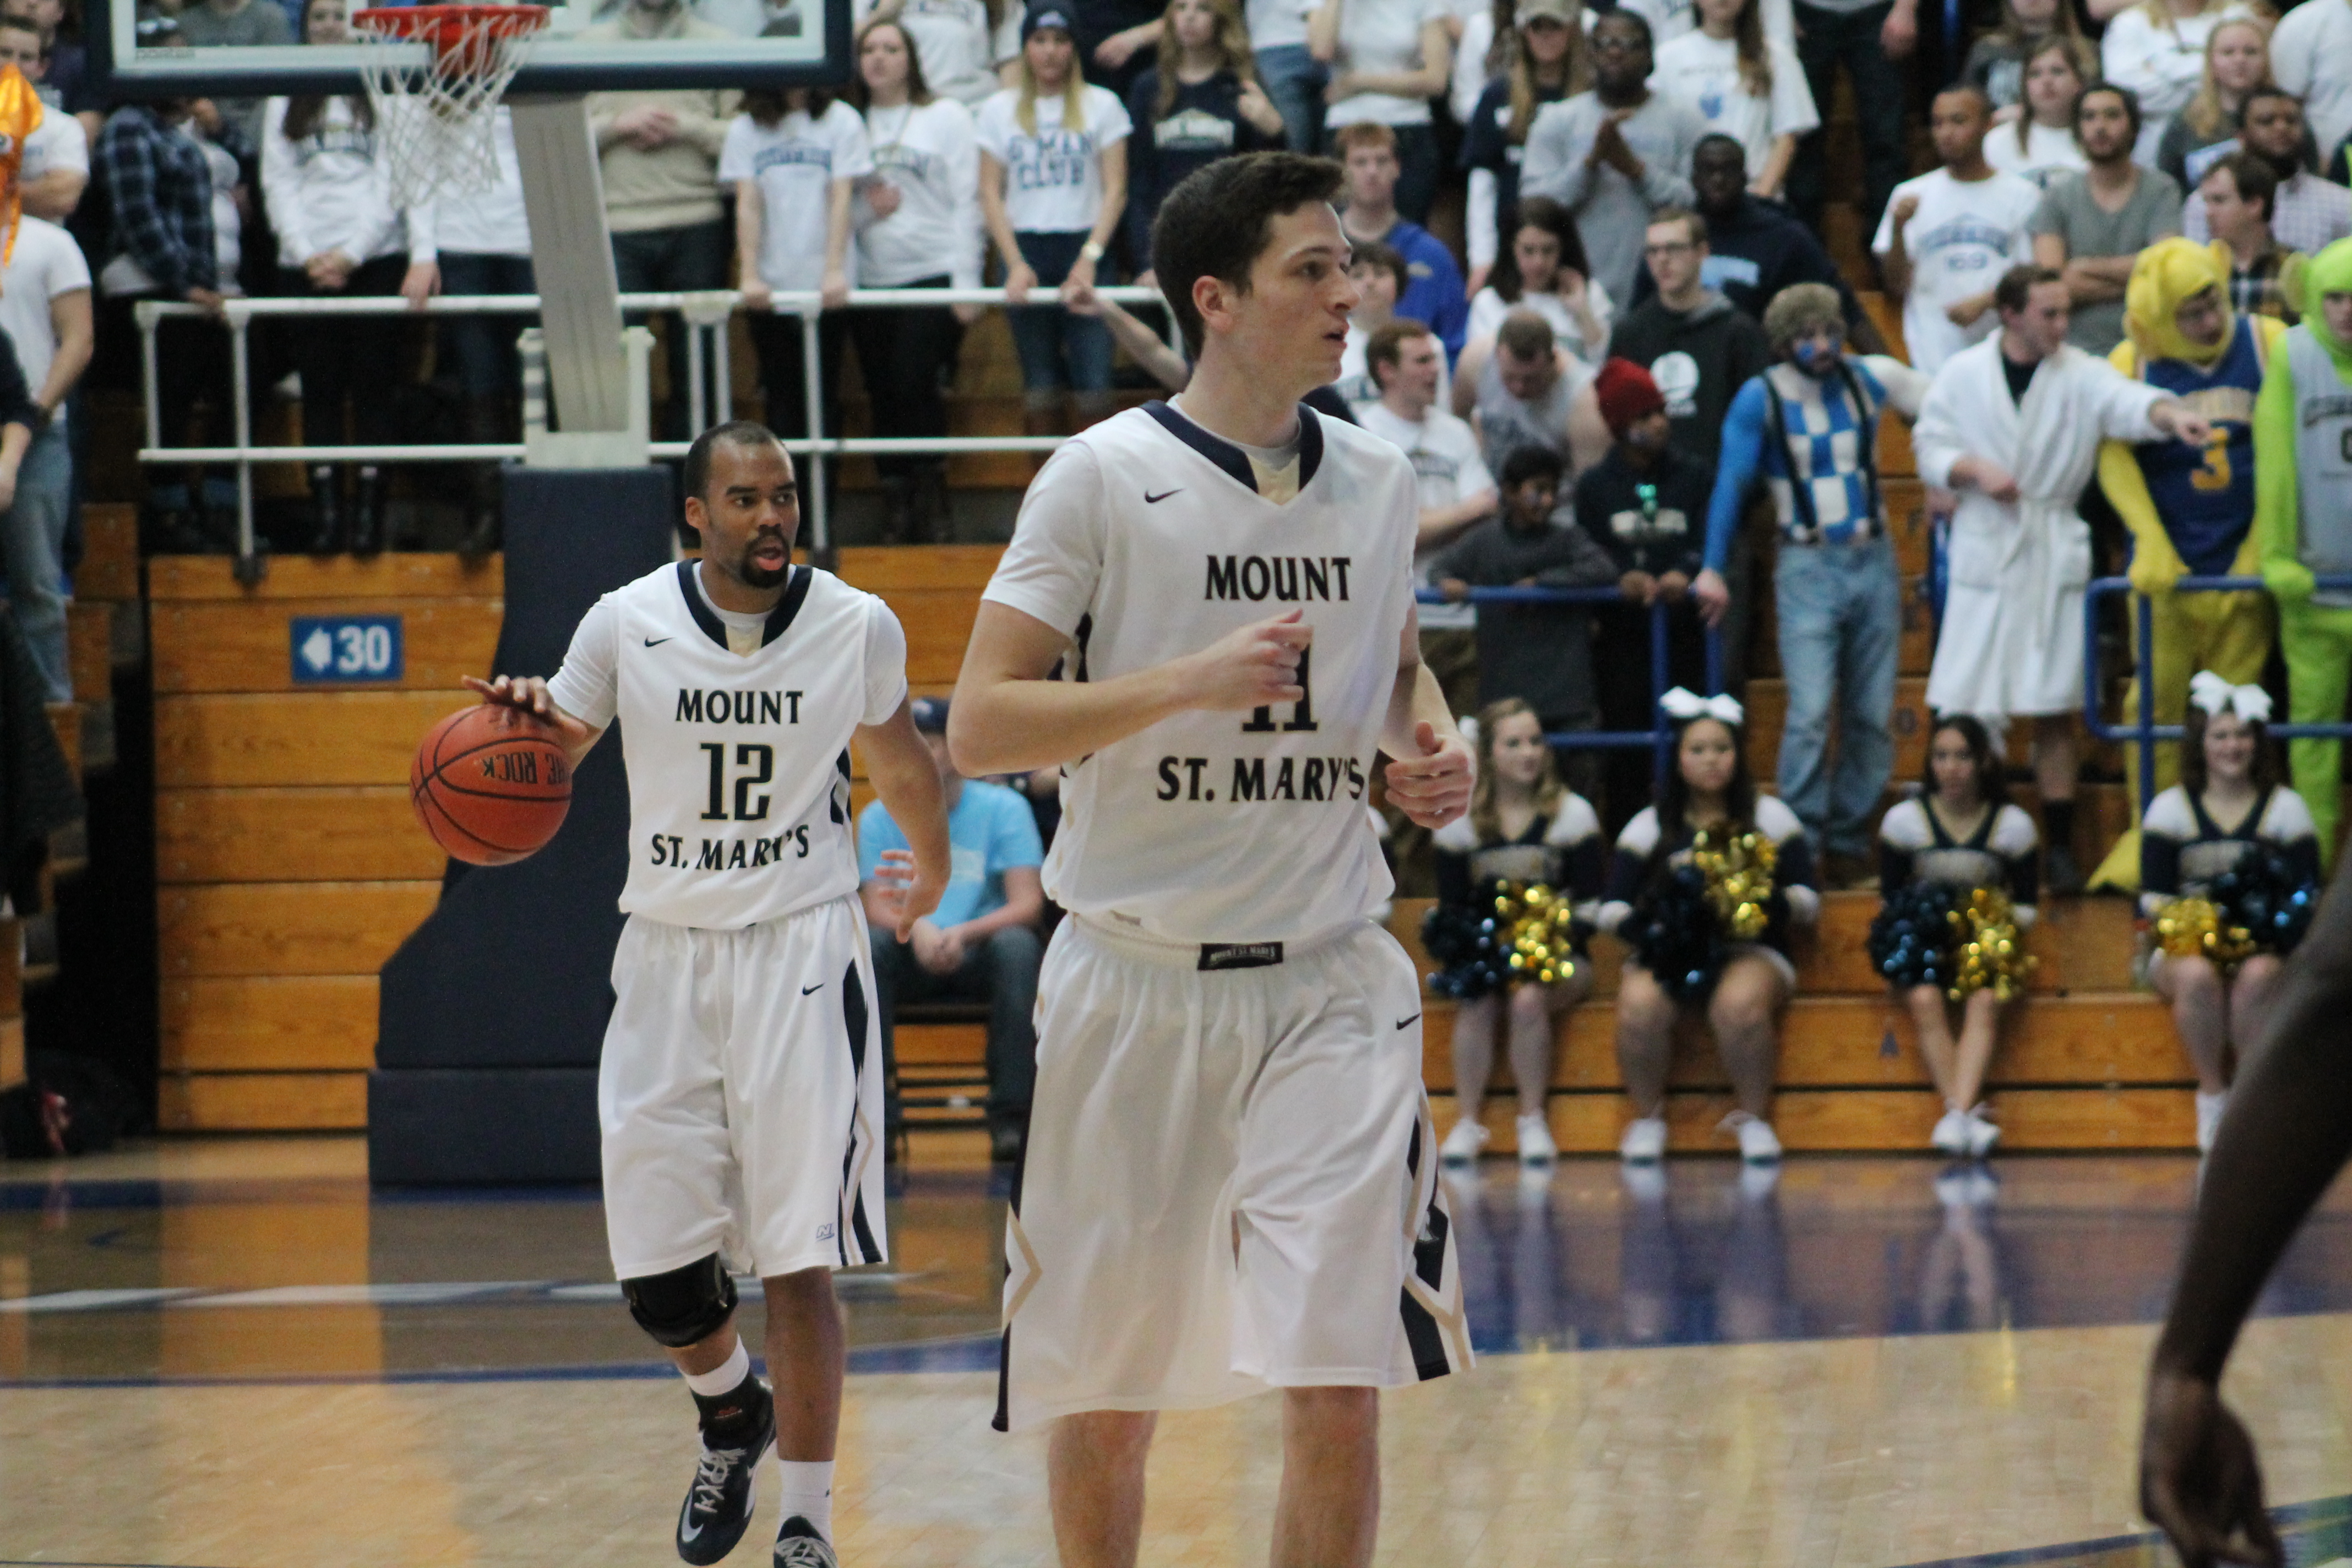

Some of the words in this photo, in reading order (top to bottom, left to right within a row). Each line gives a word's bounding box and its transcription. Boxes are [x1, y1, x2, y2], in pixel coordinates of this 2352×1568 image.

[1017, 159, 1085, 189] CLUB
[2190, 426, 2231, 491] 3
[1205, 554, 1351, 602] MOUNT
[338, 625, 391, 673] 30
[675, 688, 803, 725] MOUNT
[482, 751, 538, 785] ROCK
[699, 742, 774, 821] 12
[1157, 755, 1215, 802] ST.
[1231, 756, 1365, 802] MARY'S
[651, 832, 688, 869] ST.
[695, 824, 809, 870] MARY'S
